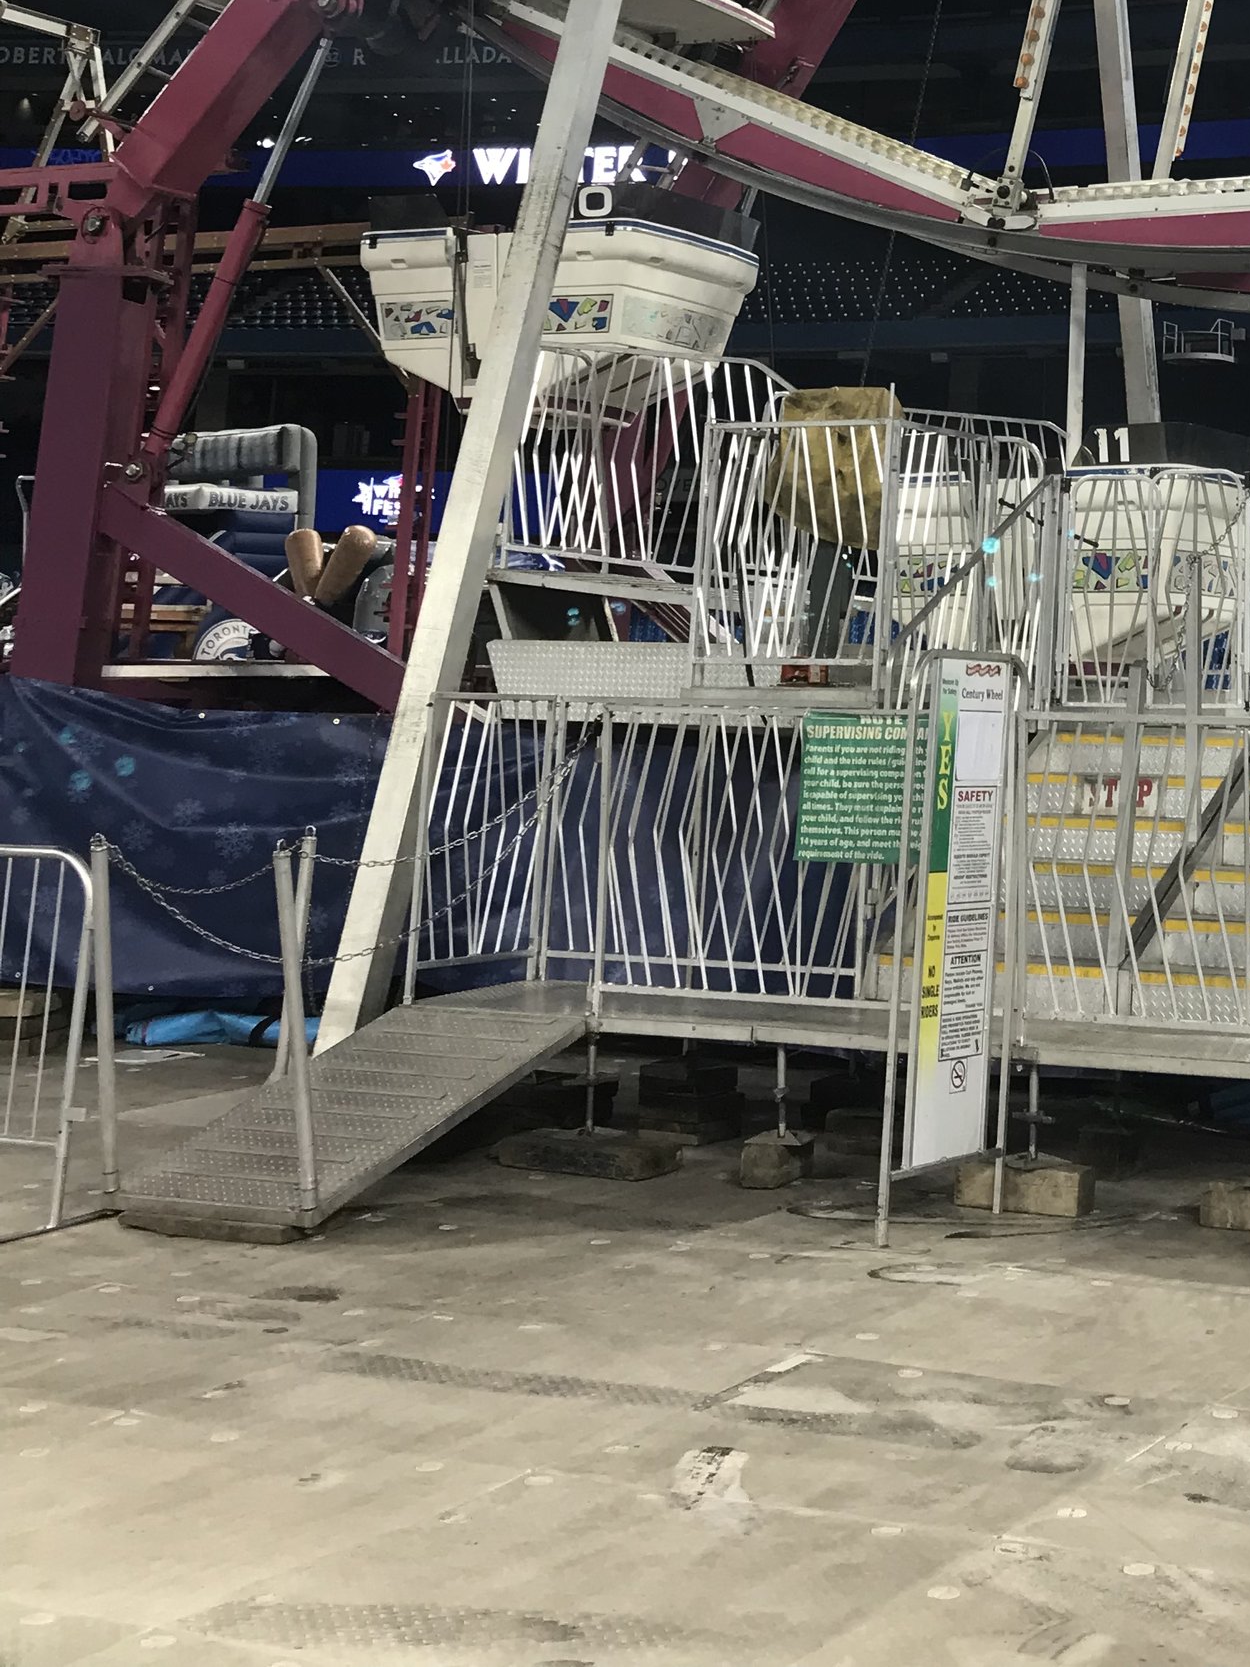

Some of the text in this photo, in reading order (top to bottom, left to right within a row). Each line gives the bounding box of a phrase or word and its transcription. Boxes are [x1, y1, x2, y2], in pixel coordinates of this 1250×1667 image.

[1094, 427, 1130, 462] 11
[208, 493, 290, 512] BLUE JAYS
[962, 687, 1003, 702] Century Wheel
[807, 725, 882, 740] SUPERVISING
[806, 744, 833, 753] Parents
[834, 744, 840, 753] if
[841, 746, 855, 755] you
[856, 746, 868, 754] are
[869, 746, 882, 754] not
[883, 745, 905, 757] riding
[804, 755, 823, 764] child
[824, 756, 838, 765] and
[839, 756, 851, 765] the
[852, 756, 867, 765] ride
[868, 756, 887, 766] rules
[938, 711, 955, 810] YES
[804, 766, 815, 776] call
[816, 767, 829, 776] for
[836, 768, 879, 779] supervising
[804, 780, 819, 789] your
[842, 779, 853, 789] be
[853, 781, 870, 789] sure
[871, 780, 884, 790] the
[809, 790, 838, 801] capable
[839, 790, 848, 800] of
[848, 791, 893, 803] supervising
[958, 790, 993, 803] SAFETY
[1089, 778, 1153, 808] STP
[802, 801, 811, 811] all
[834, 802, 853, 814] They
[854, 804, 874, 813] must
[874, 804, 903, 815] explain
[801, 814, 817, 824] your
[839, 814, 854, 823] and
[855, 814, 880, 824] follow
[880, 815, 893, 825] the
[800, 824, 843, 835] themselves.
[843, 825, 860, 836] This
[860, 828, 887, 838] person
[800, 836, 809, 846] 14
[809, 838, 828, 848] years
[829, 837, 839, 846] of
[856, 839, 871, 848] and
[871, 840, 892, 849] meet
[844, 849, 854, 859] of
[854, 850, 866, 859] the
[866, 850, 885, 860] ride.
[948, 915, 960, 923] RIDE
[961, 913, 988, 922] GUIDELINES
[950, 954, 981, 965] ATTENTION
[928, 965, 936, 978] NO
[922, 984, 939, 999] SINGLE
[921, 1004, 938, 1019] RIDERS
